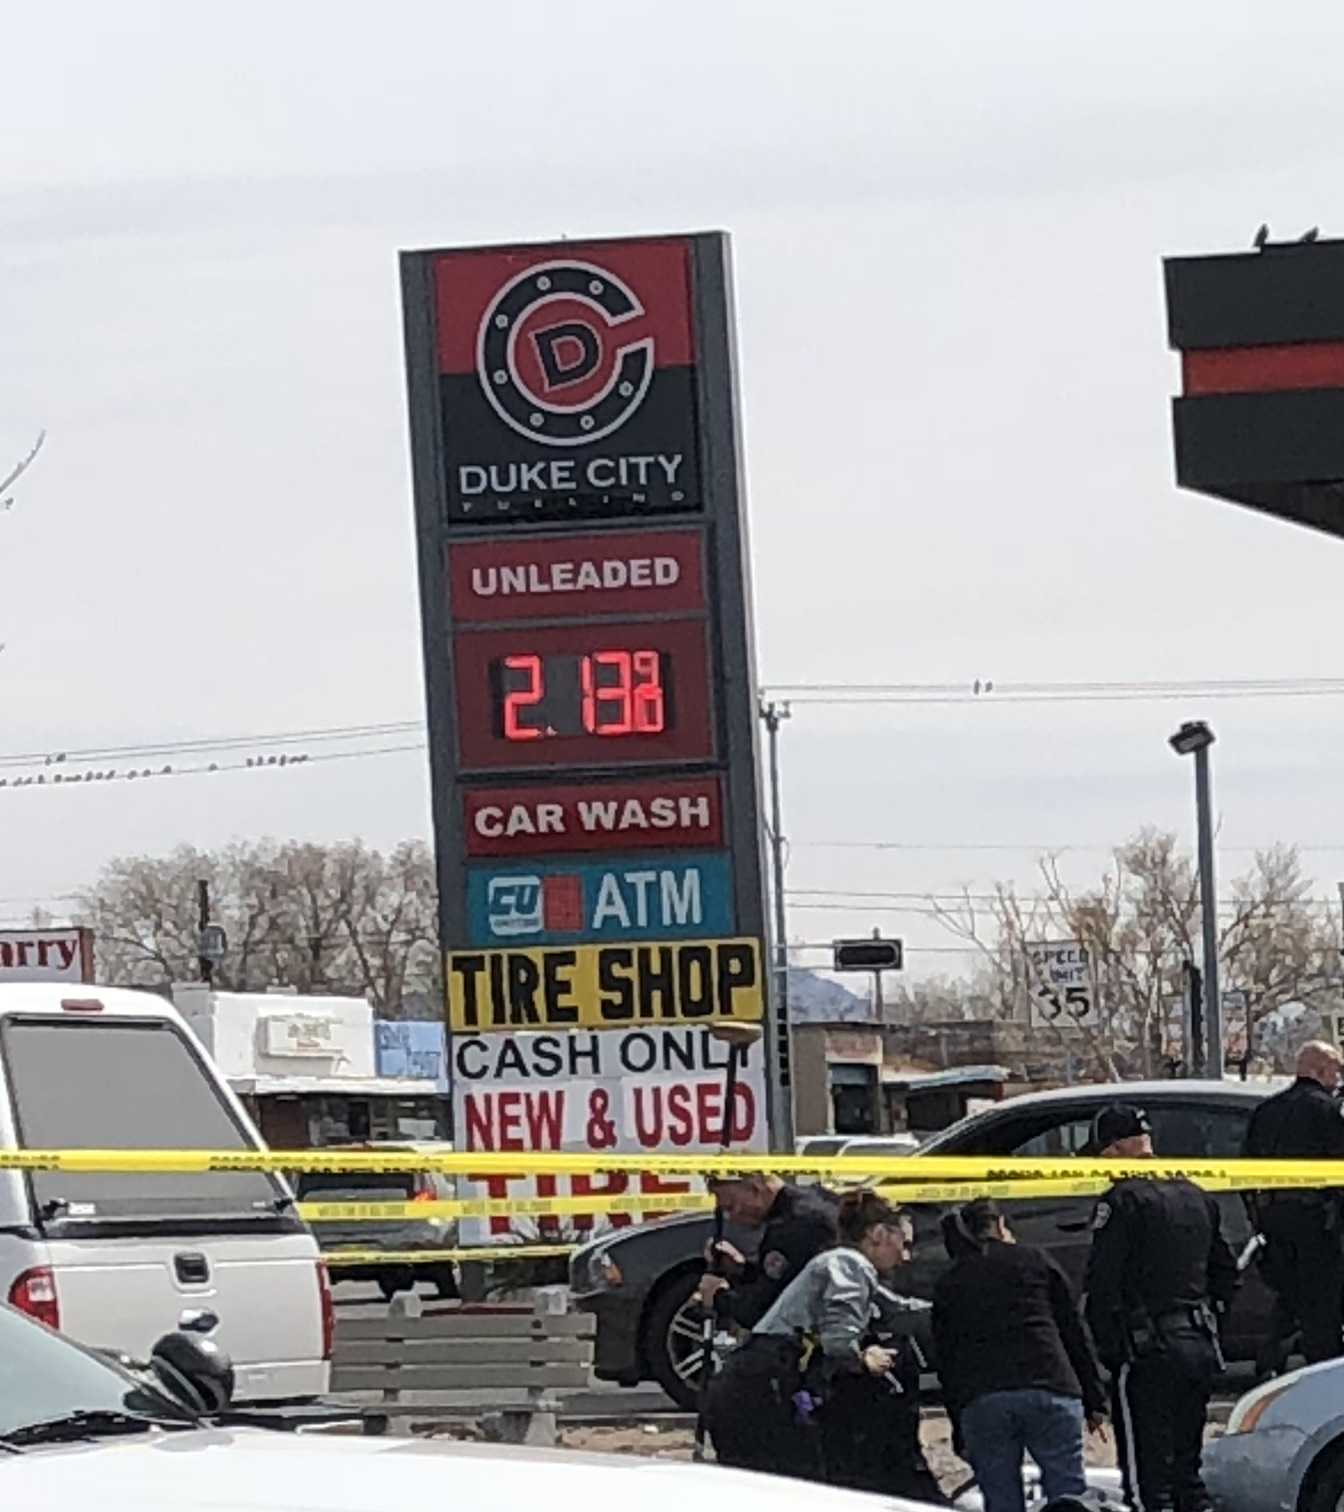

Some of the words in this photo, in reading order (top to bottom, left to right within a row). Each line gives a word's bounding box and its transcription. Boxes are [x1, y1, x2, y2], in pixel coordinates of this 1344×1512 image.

[459, 460, 577, 495] DUKE
[586, 454, 683, 488] CITY
[472, 557, 680, 596] UNLEADED
[474, 803, 566, 838] CAR
[577, 797, 710, 831] WASH
[591, 868, 702, 929] ATM
[452, 951, 579, 1027] TIRE
[599, 943, 756, 1020] SHOP
[1037, 986, 1091, 1020] 35
[456, 1034, 601, 1080] CASH
[463, 1089, 565, 1152] NEW
[586, 1087, 618, 1150] &
[633, 1081, 756, 1149] USED
